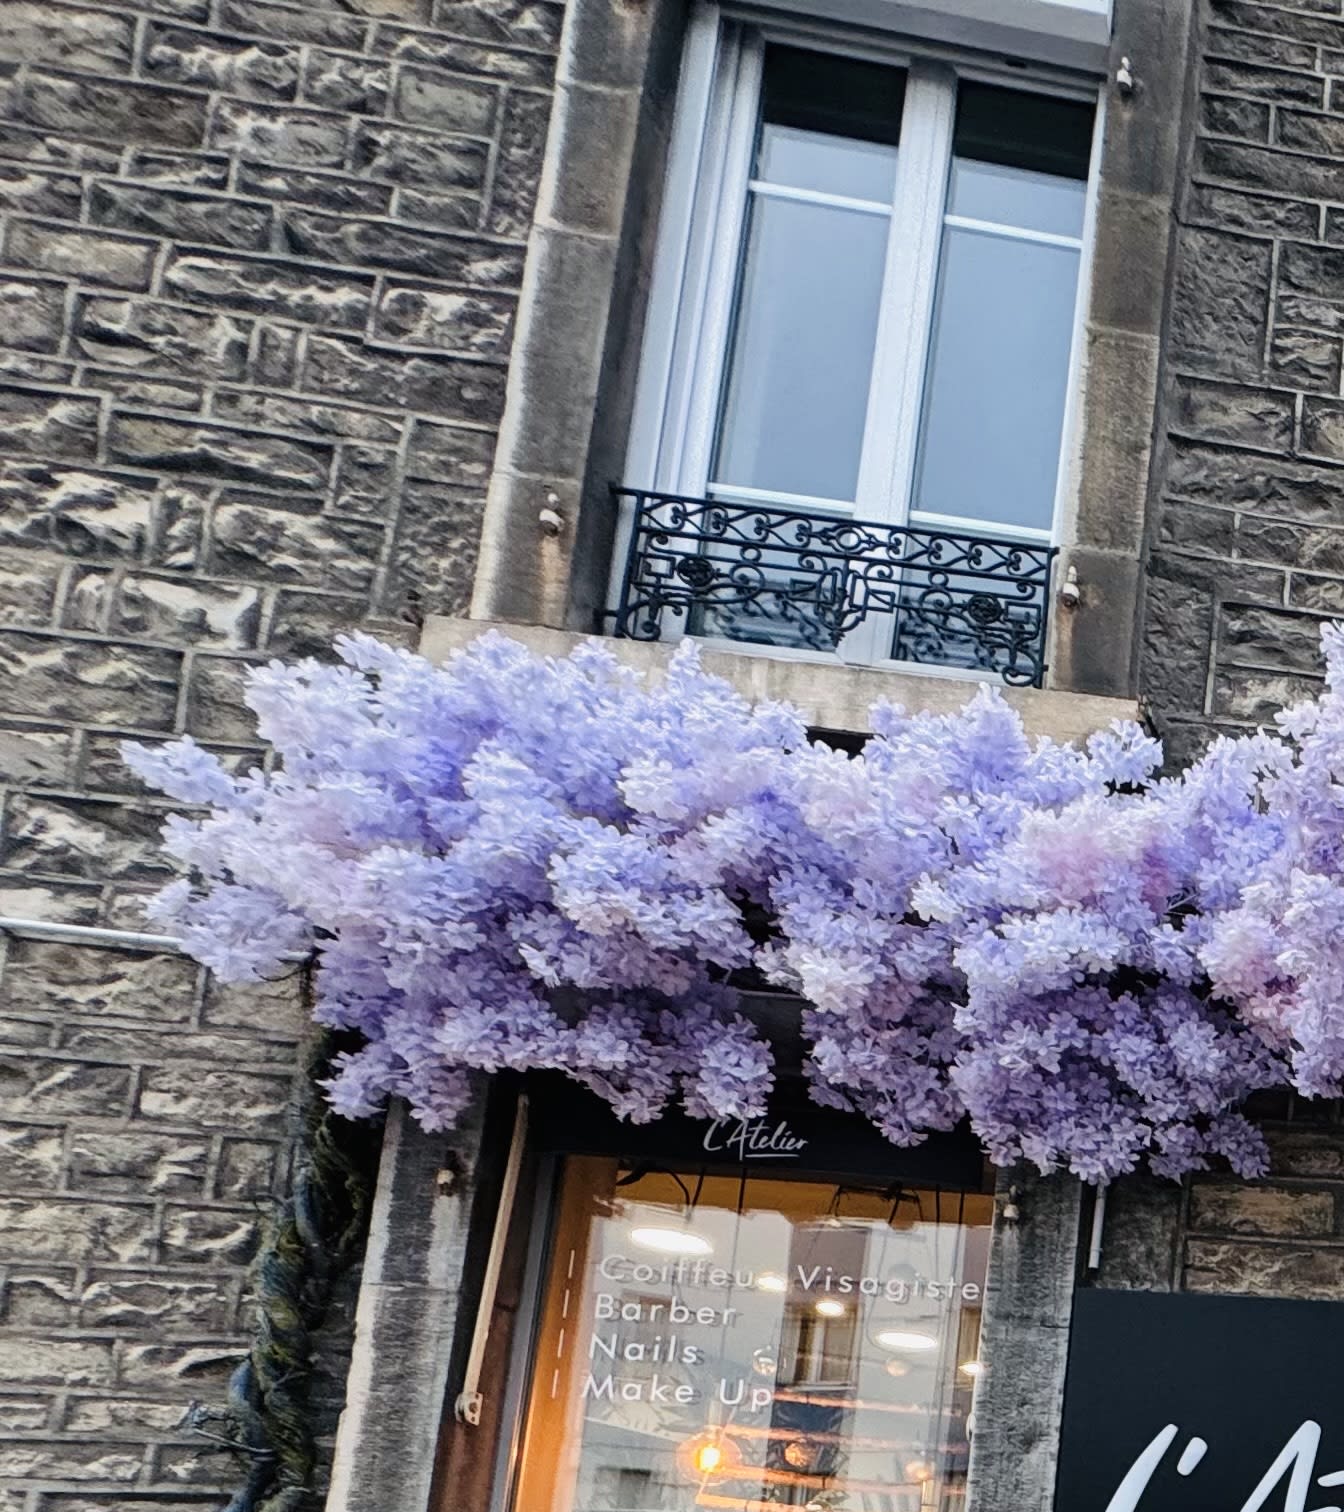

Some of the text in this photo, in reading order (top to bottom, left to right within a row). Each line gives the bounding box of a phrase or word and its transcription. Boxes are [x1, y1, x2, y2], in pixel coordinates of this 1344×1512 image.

[703, 1117, 808, 1160] L'Atelier
[601, 1254, 981, 1301] Coiffeu Visagiste
[595, 1293, 737, 1325] Barber
[589, 1333, 698, 1364] Nails
[581, 1373, 773, 1412] Make Up
